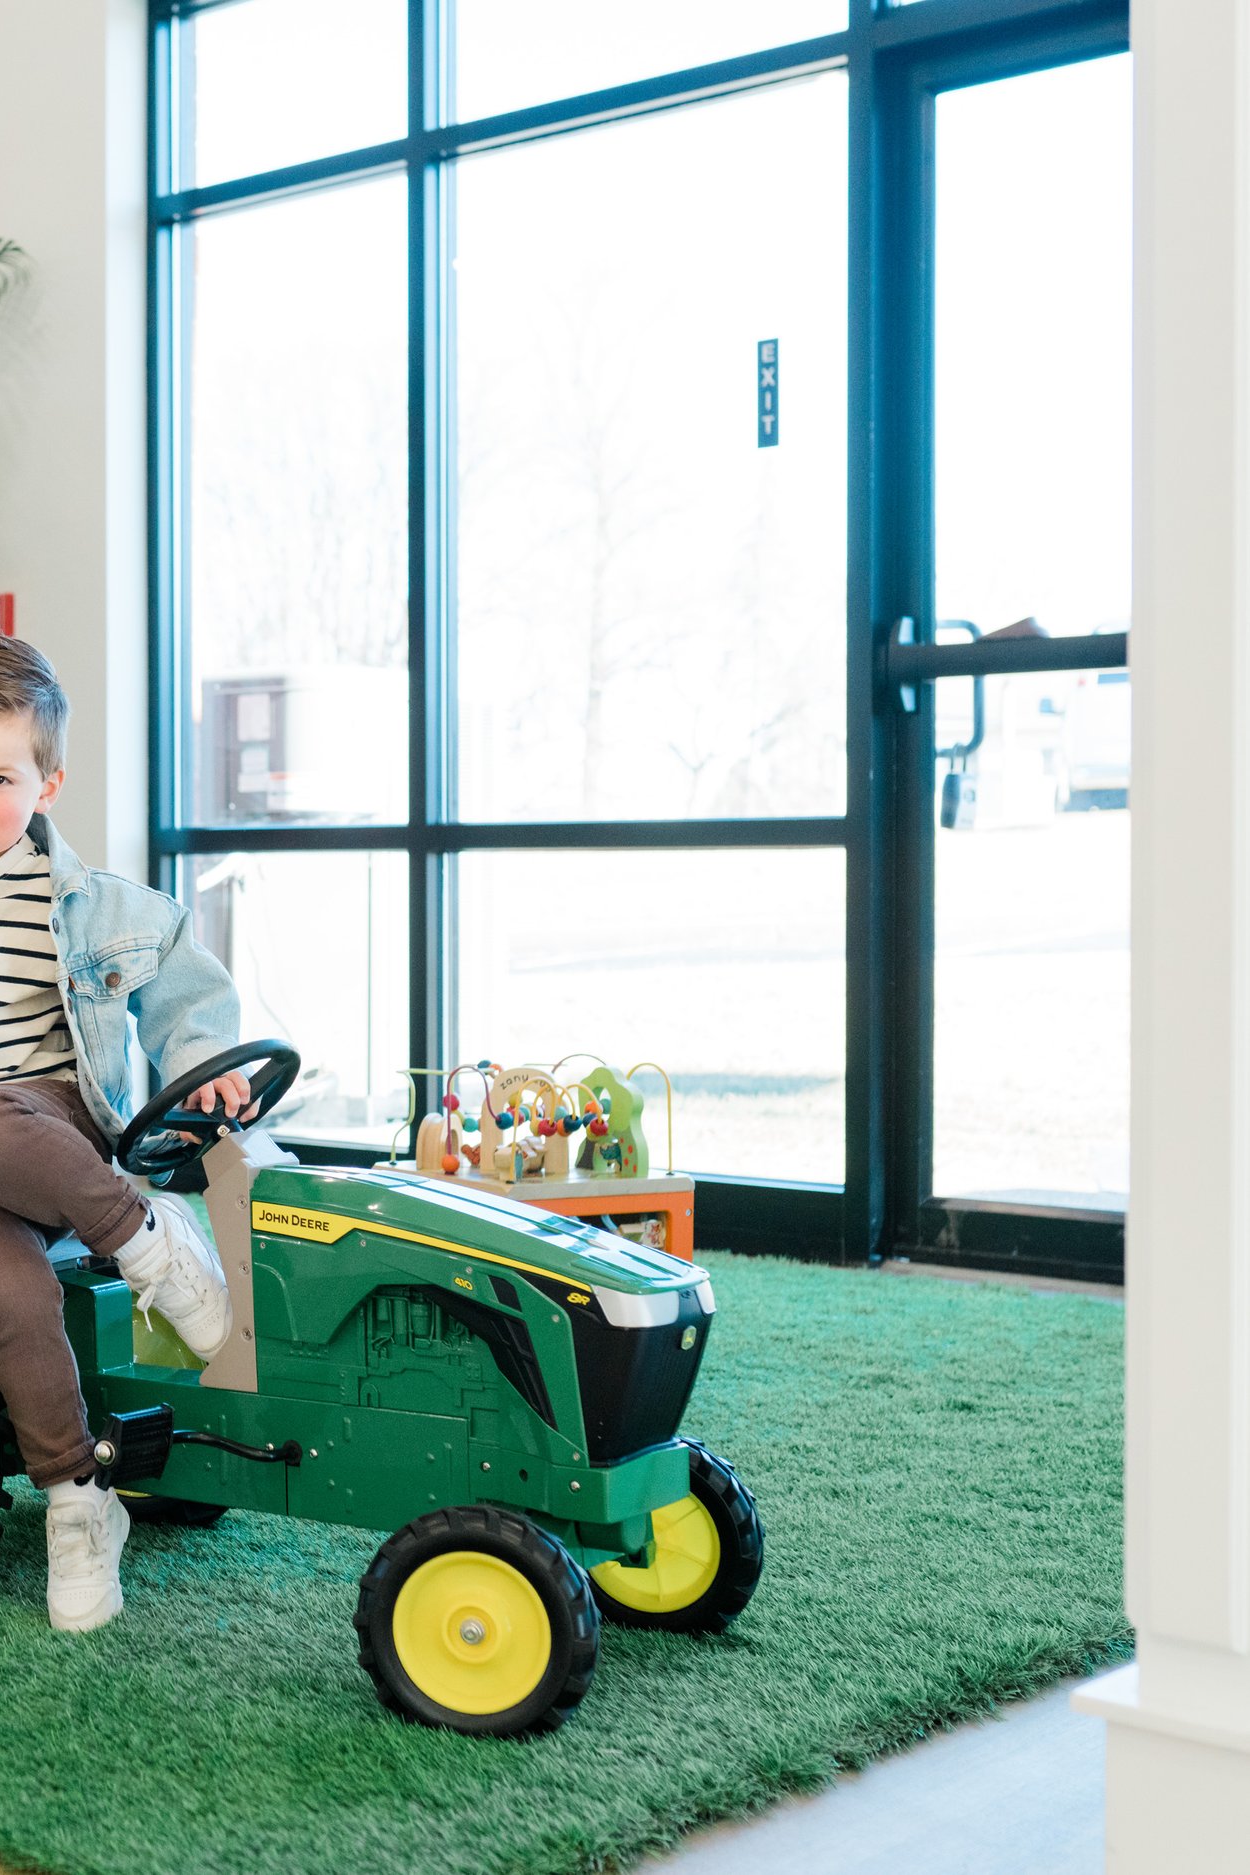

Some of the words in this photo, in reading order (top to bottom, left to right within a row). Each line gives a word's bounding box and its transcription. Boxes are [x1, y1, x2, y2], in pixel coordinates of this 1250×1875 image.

[761, 342, 775, 435] EXIT
[259, 1210, 289, 1224] JOHN
[291, 1215, 330, 1231] DEERE
[567, 1292, 591, 1305] 8R
